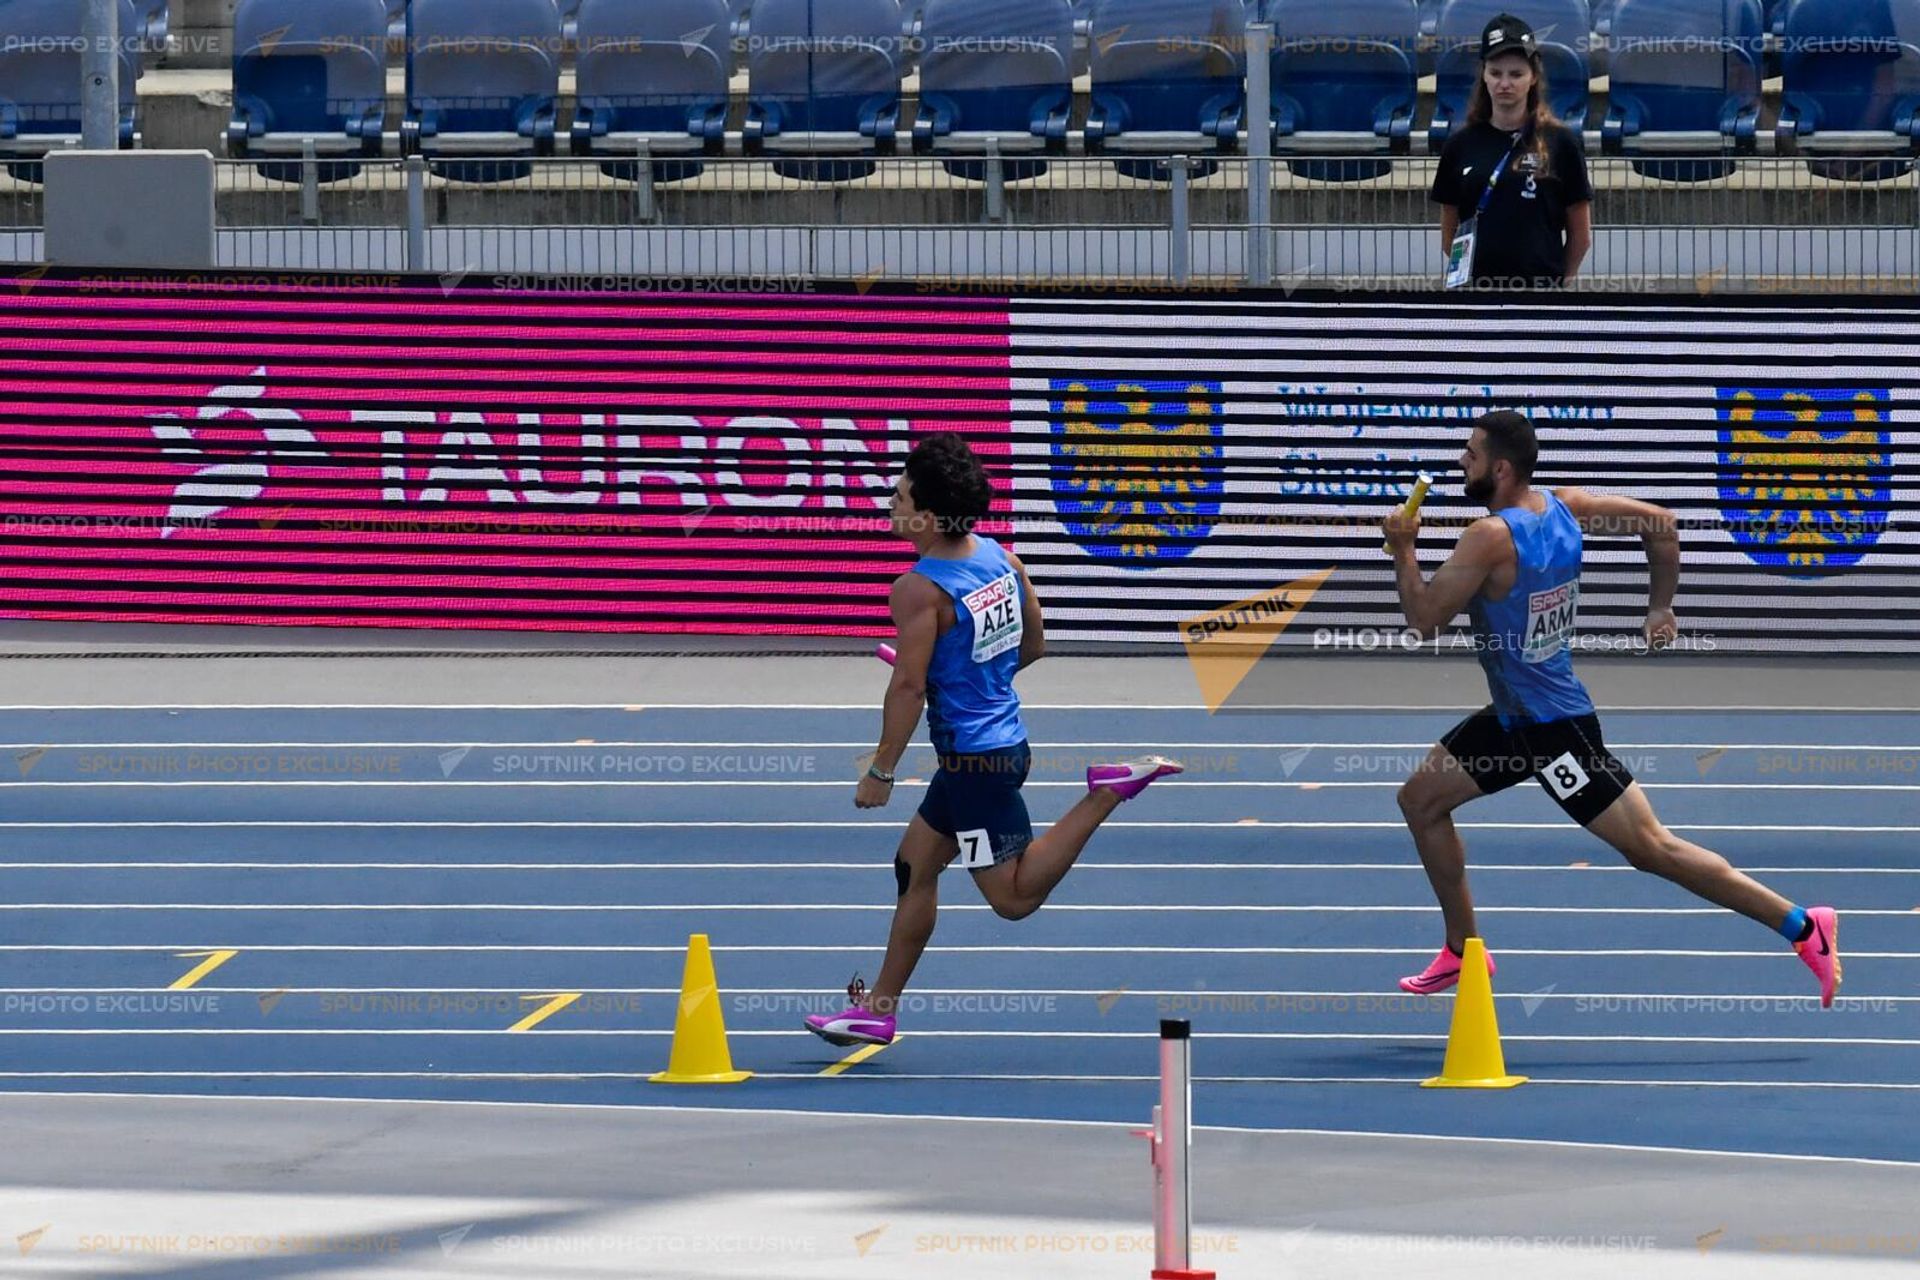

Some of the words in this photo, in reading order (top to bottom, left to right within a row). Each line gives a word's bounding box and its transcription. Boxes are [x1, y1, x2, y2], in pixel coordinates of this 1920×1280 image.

[351, 410, 911, 507] TAURON
[967, 582, 1005, 612] SPAR
[1532, 588, 1568, 612] SPAR
[981, 599, 1015, 637] AZE
[1532, 602, 1574, 639] ARM
[1553, 764, 1578, 790] 8
[963, 836, 979, 862] 7
